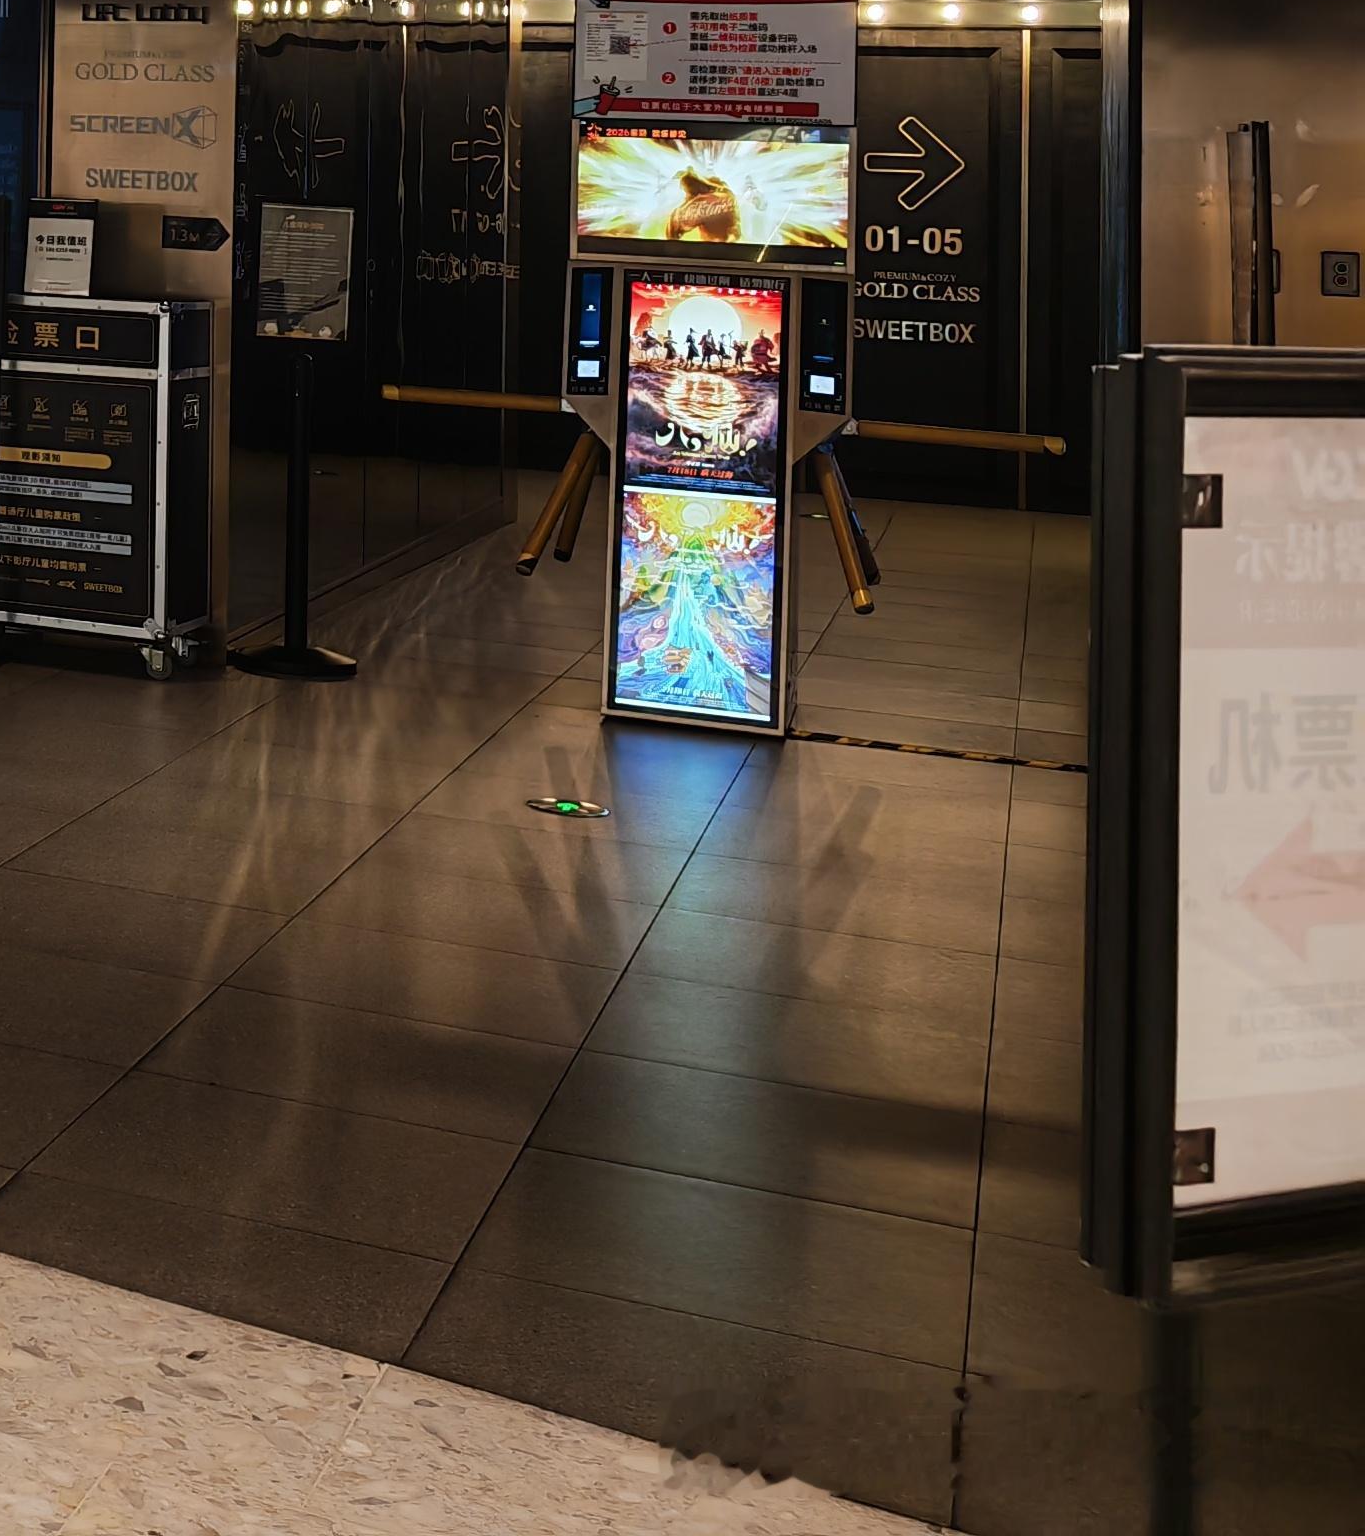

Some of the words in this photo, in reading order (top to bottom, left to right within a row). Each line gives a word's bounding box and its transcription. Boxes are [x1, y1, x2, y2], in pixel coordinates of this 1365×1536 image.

[689, 22, 769, 33] 不可用电子二维码
[75, 62, 139, 81] GOLD
[143, 62, 215, 83] CLASS
[70, 109, 204, 146] SCREENX
[85, 167, 199, 193] SWEETBOX
[35, 234, 87, 246] 今日我值班
[865, 225, 964, 255] 01-05
[873, 271, 957, 283] PREMIUM&COZY
[912, 284, 981, 303] CLASS
[853, 318, 977, 344] SWEETBOX
